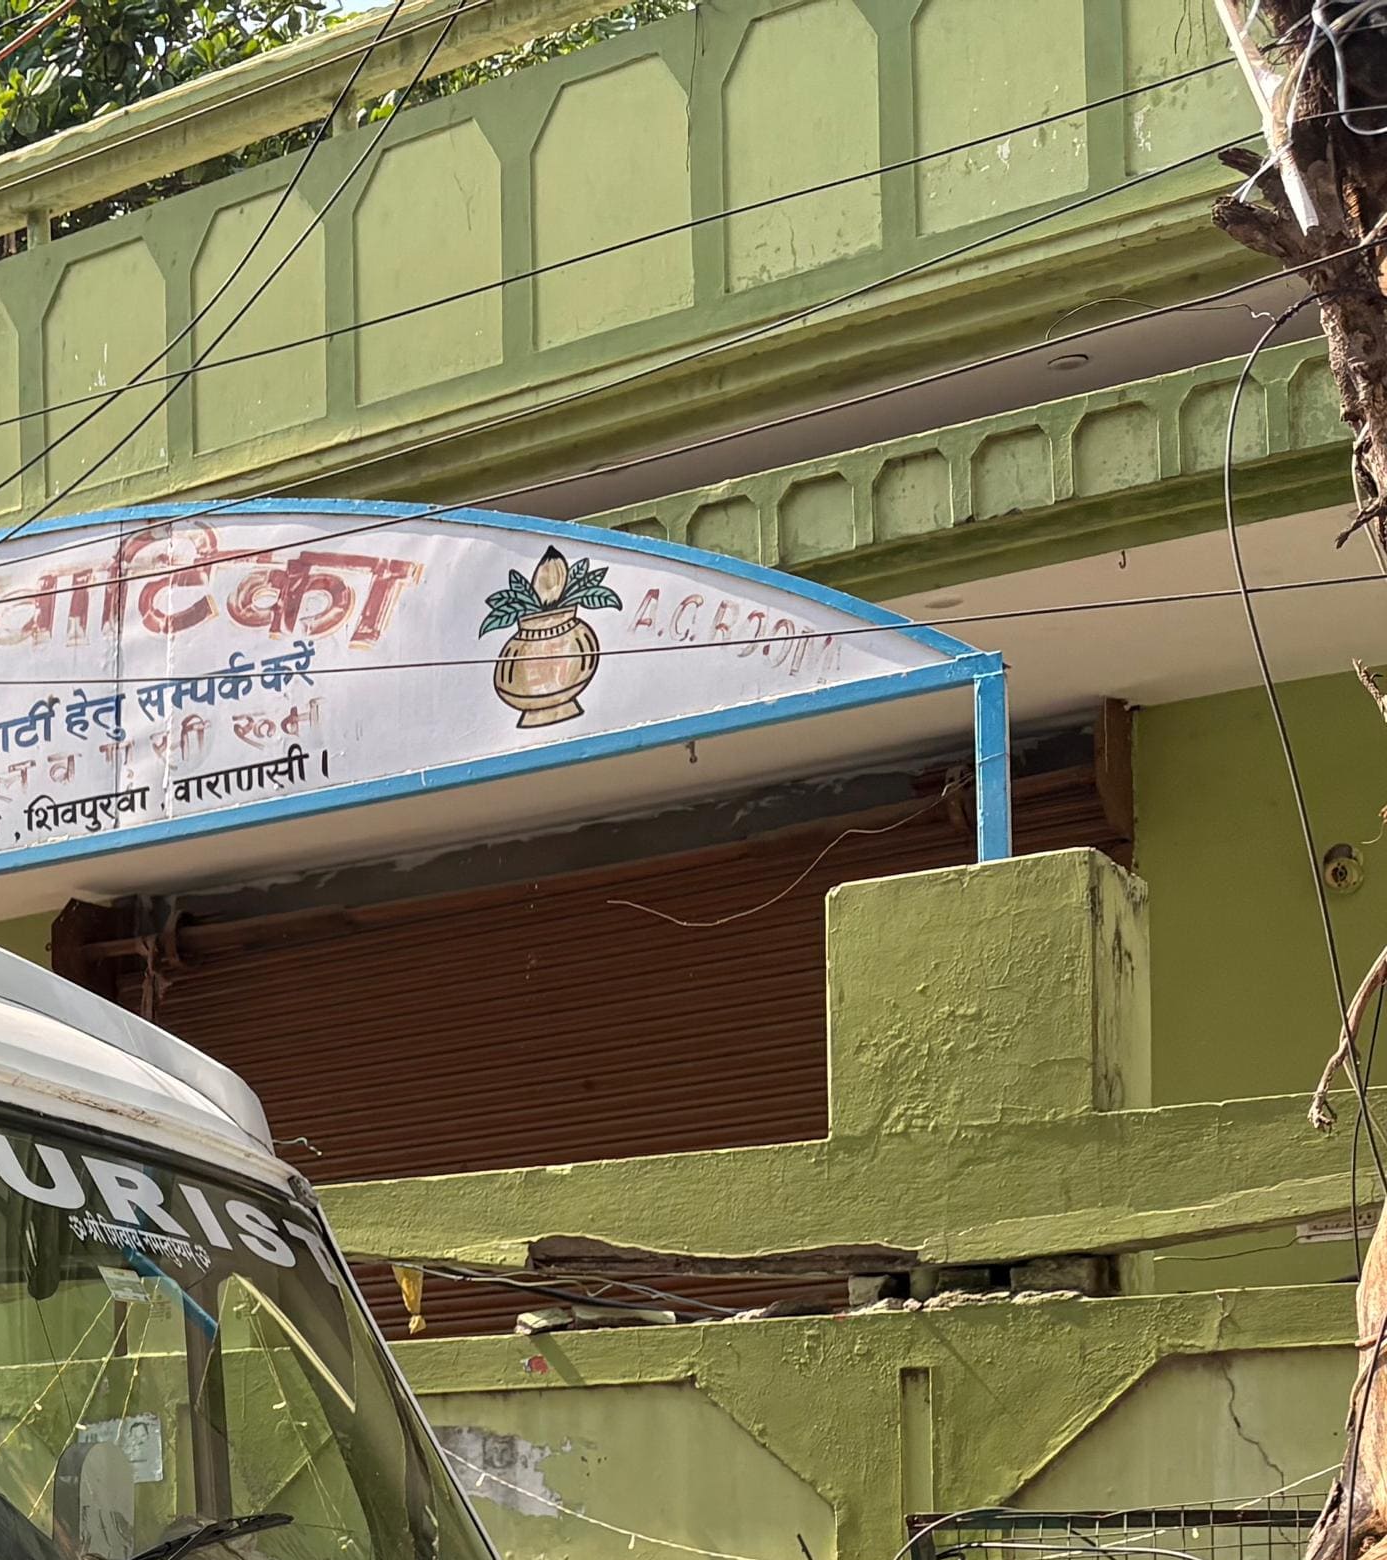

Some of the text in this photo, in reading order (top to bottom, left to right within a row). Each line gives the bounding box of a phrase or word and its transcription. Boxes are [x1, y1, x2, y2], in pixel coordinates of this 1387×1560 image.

[65, 689, 126, 742] हेतु
[137, 652, 255, 722] सम्पर्क
[261, 640, 316, 692] करें
